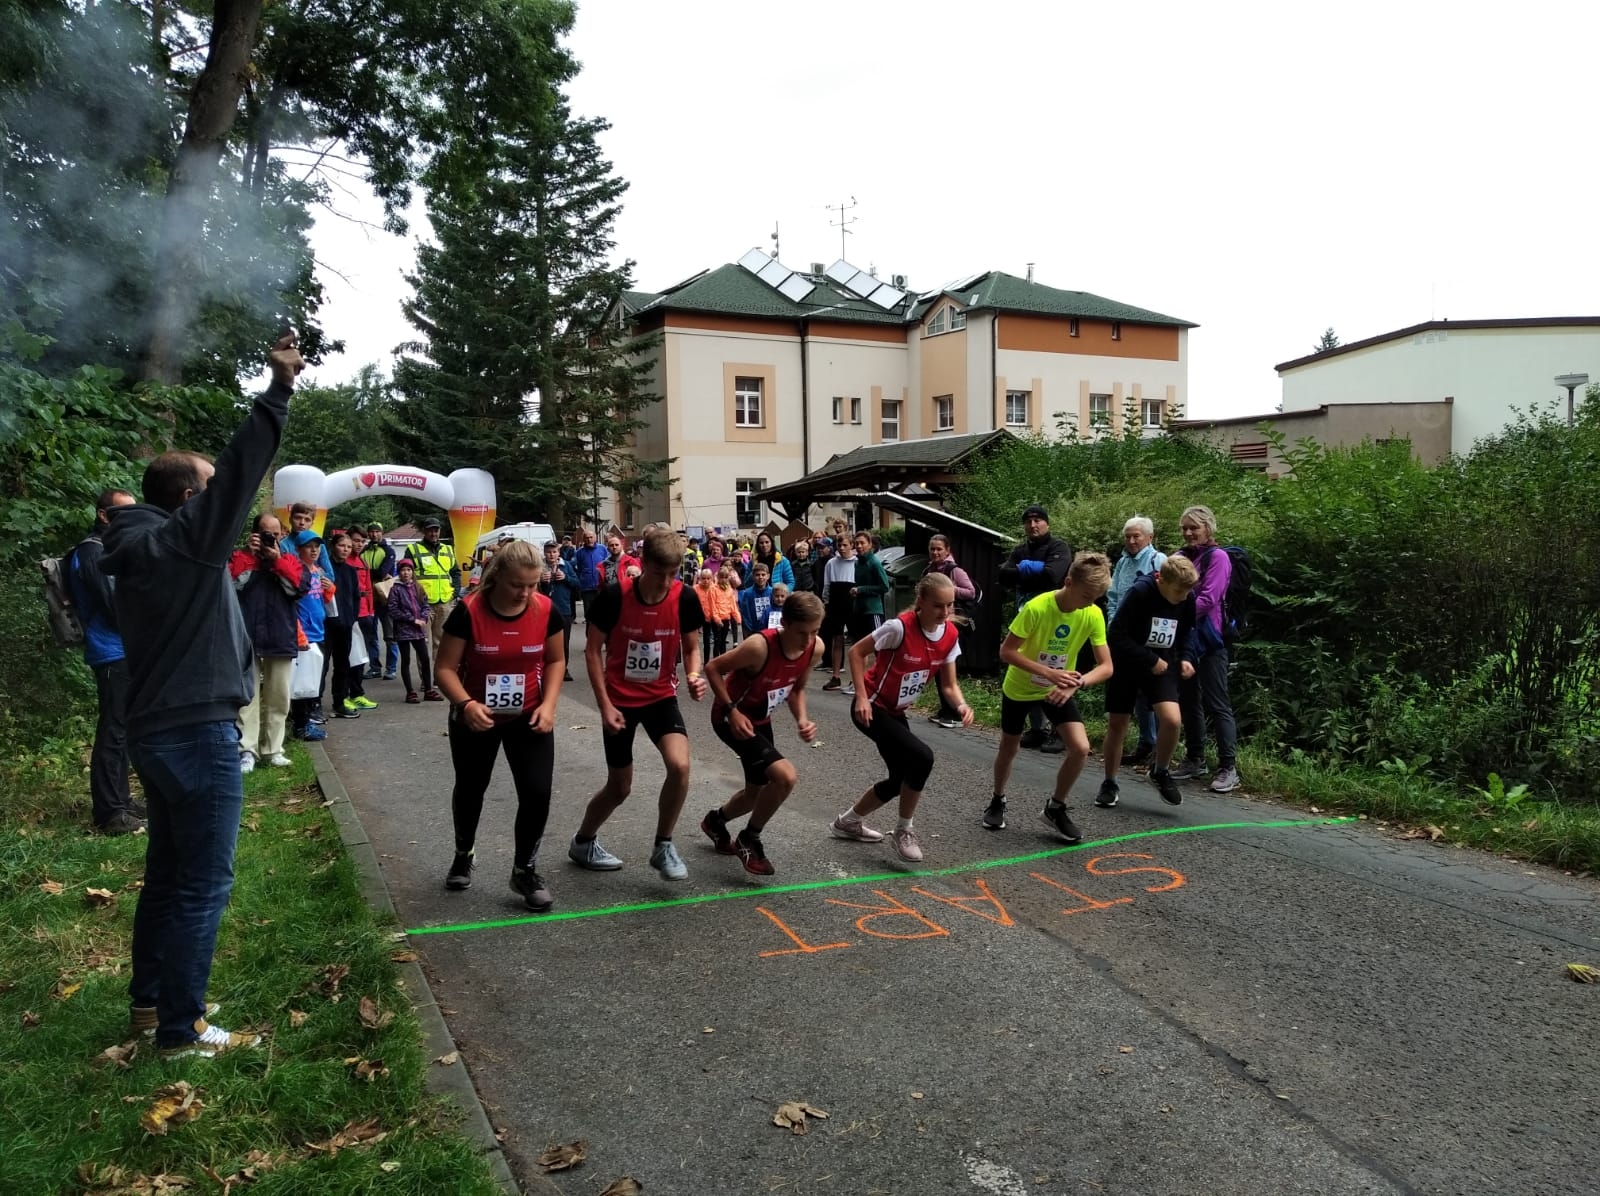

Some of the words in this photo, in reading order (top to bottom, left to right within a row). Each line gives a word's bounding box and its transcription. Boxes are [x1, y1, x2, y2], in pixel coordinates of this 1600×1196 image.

[379, 473, 424, 488] PRIMATOR
[1148, 631, 1173, 646] 301
[626, 656, 661, 671] 304
[900, 682, 926, 699] 368
[486, 692, 523, 708] 358
[754, 852, 1187, 958] START
